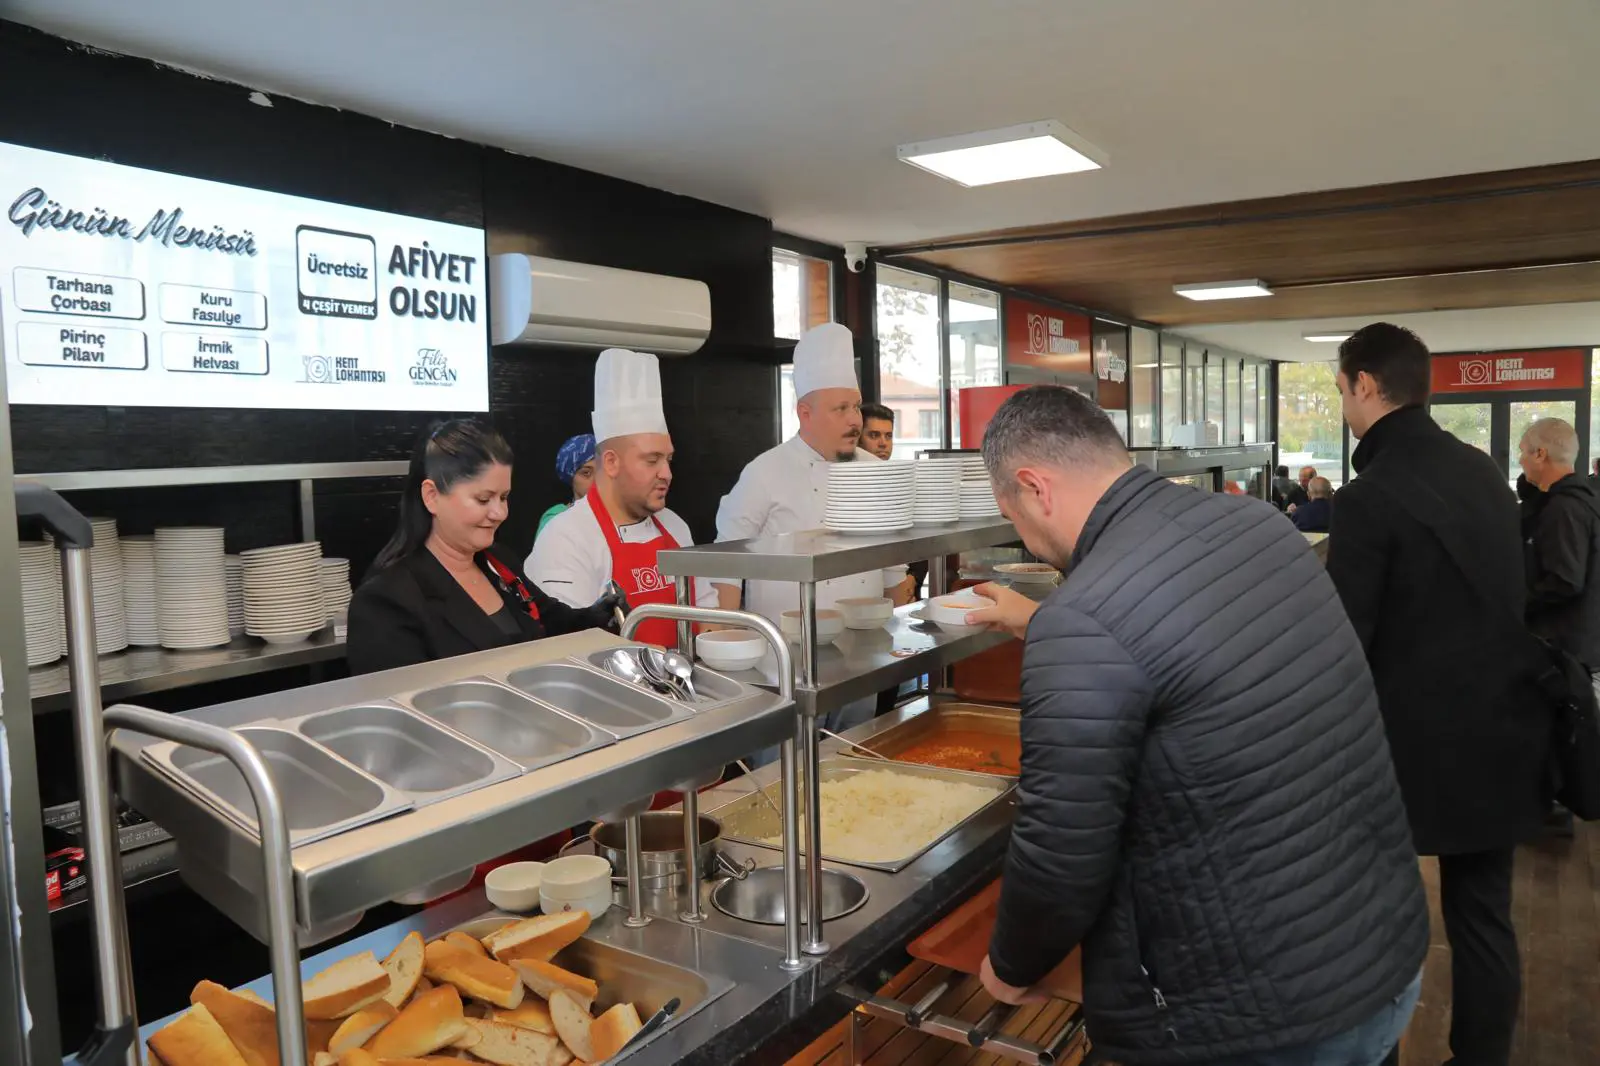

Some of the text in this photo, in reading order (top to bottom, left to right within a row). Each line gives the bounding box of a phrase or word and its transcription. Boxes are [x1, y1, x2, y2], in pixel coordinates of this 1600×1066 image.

[8, 187, 258, 257] Günün Menüsü
[307, 253, 368, 280] Ücretsiz
[388, 240, 477, 285] AFİYET
[47, 275, 114, 296] Tarhana
[51, 294, 112, 312] Çorbası
[200, 291, 232, 307] Kuru
[302, 299, 375, 316] 4 ÇEŞİT YEMEK
[389, 285, 477, 324] OLSUN
[192, 307, 242, 326] Fasulye
[60, 328, 106, 347] Pirinç
[198, 335, 233, 355] İrmik
[62, 347, 104, 363] Pilavı
[193, 355, 240, 371] Helvası
[336, 356, 358, 369] KENT
[416, 348, 448, 369] Filiz
[1495, 358, 1524, 369] KENT
[336, 368, 386, 383] LOKANTASI
[409, 366, 457, 381] GENCAN
[1496, 367, 1555, 381] LOKANTASI
